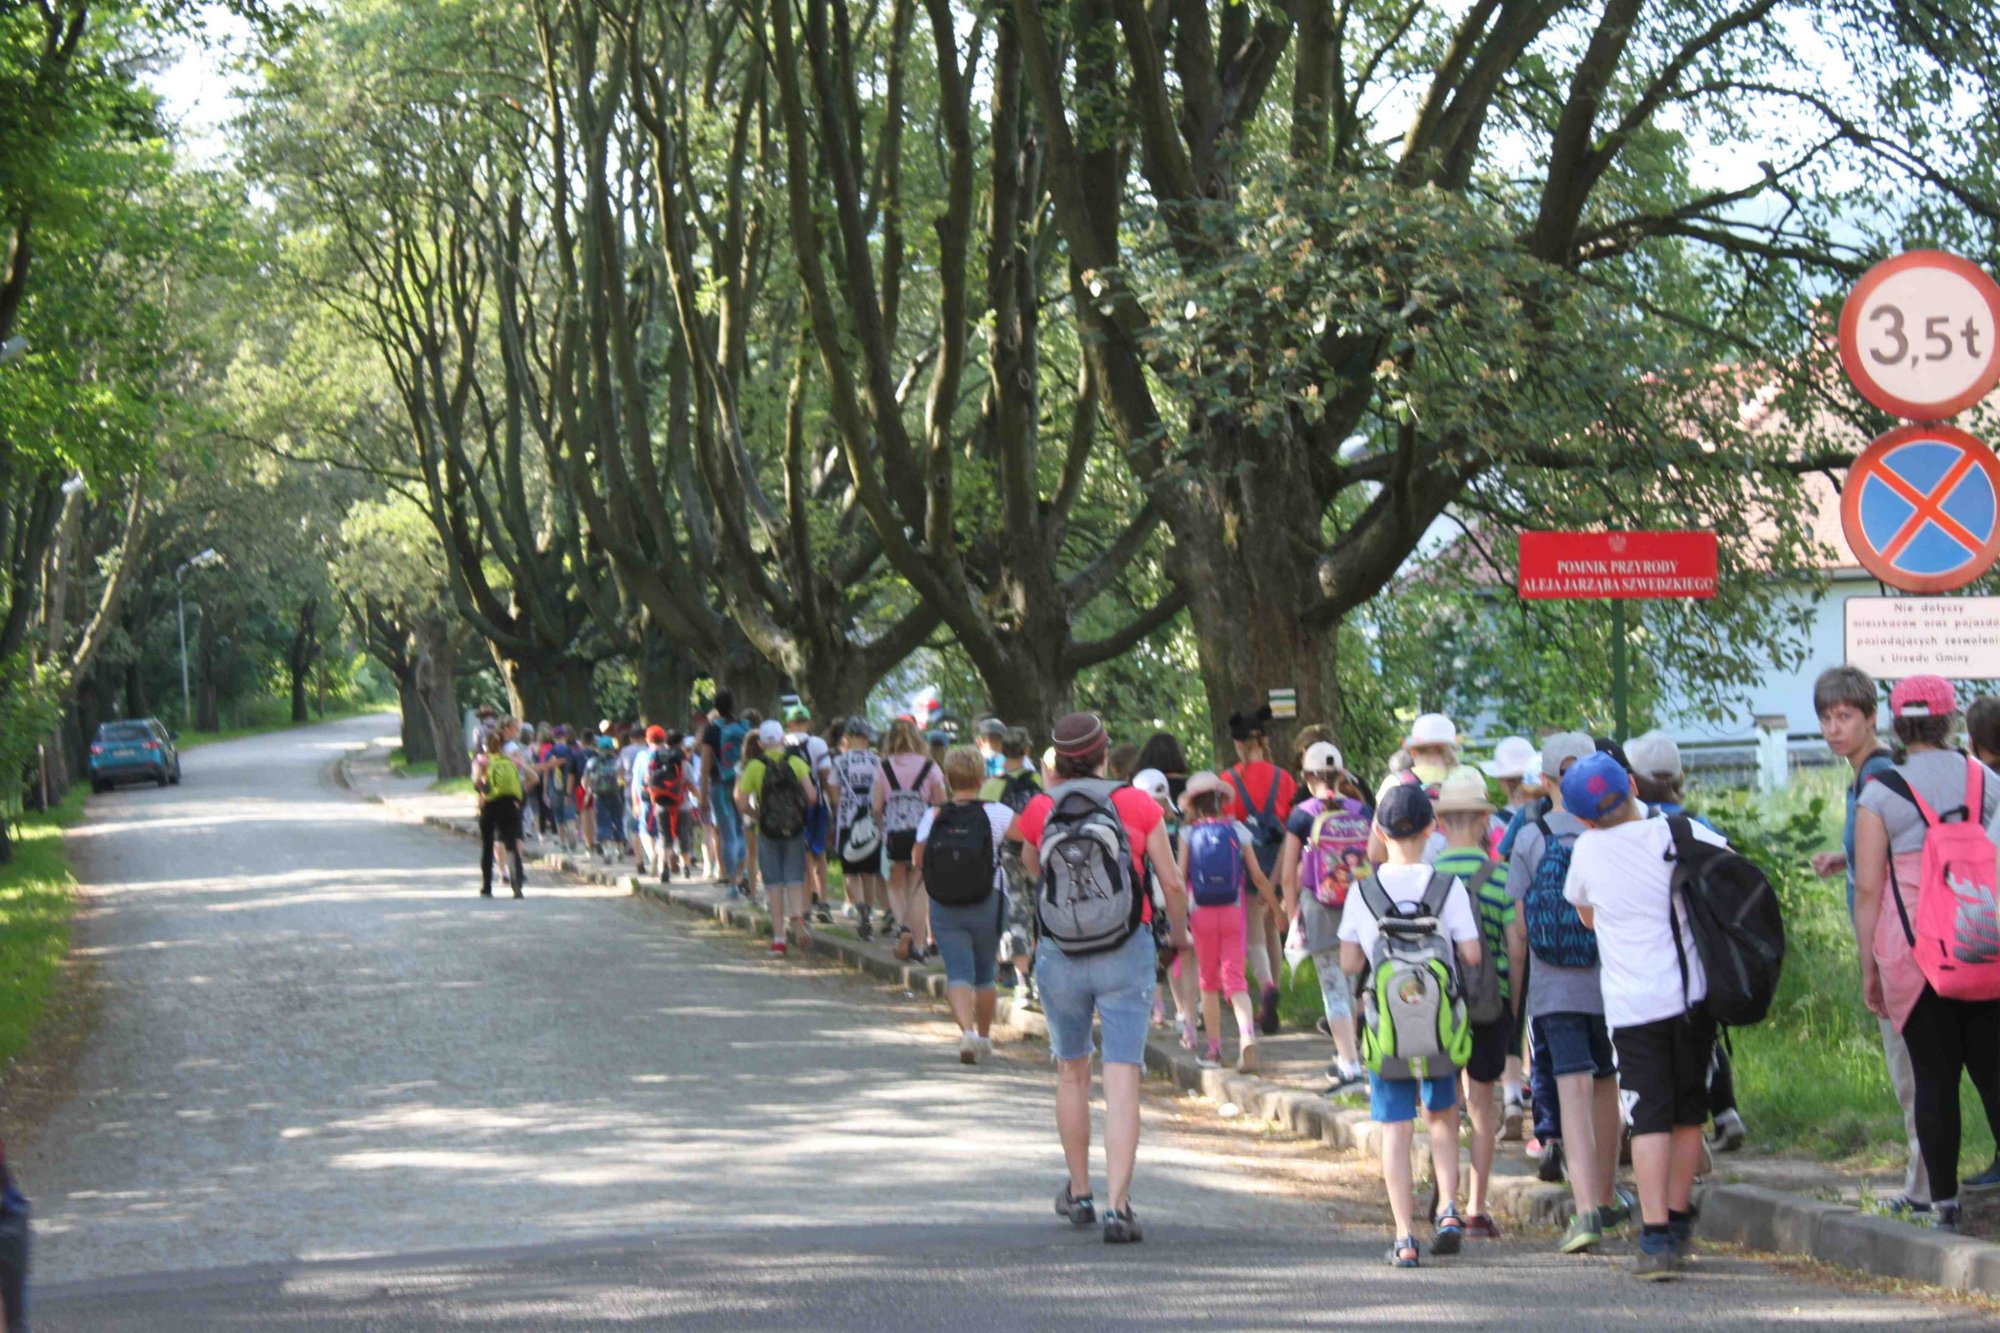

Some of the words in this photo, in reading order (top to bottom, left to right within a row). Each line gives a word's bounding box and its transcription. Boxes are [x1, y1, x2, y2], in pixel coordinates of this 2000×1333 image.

[1557, 560, 1608, 575] POMNIK
[1611, 560, 1678, 575] PRZYRODY
[1523, 577, 1561, 593] ALEJA
[1622, 577, 1714, 593] SZWEDZKIEGO
[1894, 602, 1913, 613] Nie
[1921, 602, 1964, 615] dotyczy
[1924, 619, 1947, 628] oraz
[1935, 652, 1969, 664] Gminy
[1947, 872, 1999, 963] NIKE
